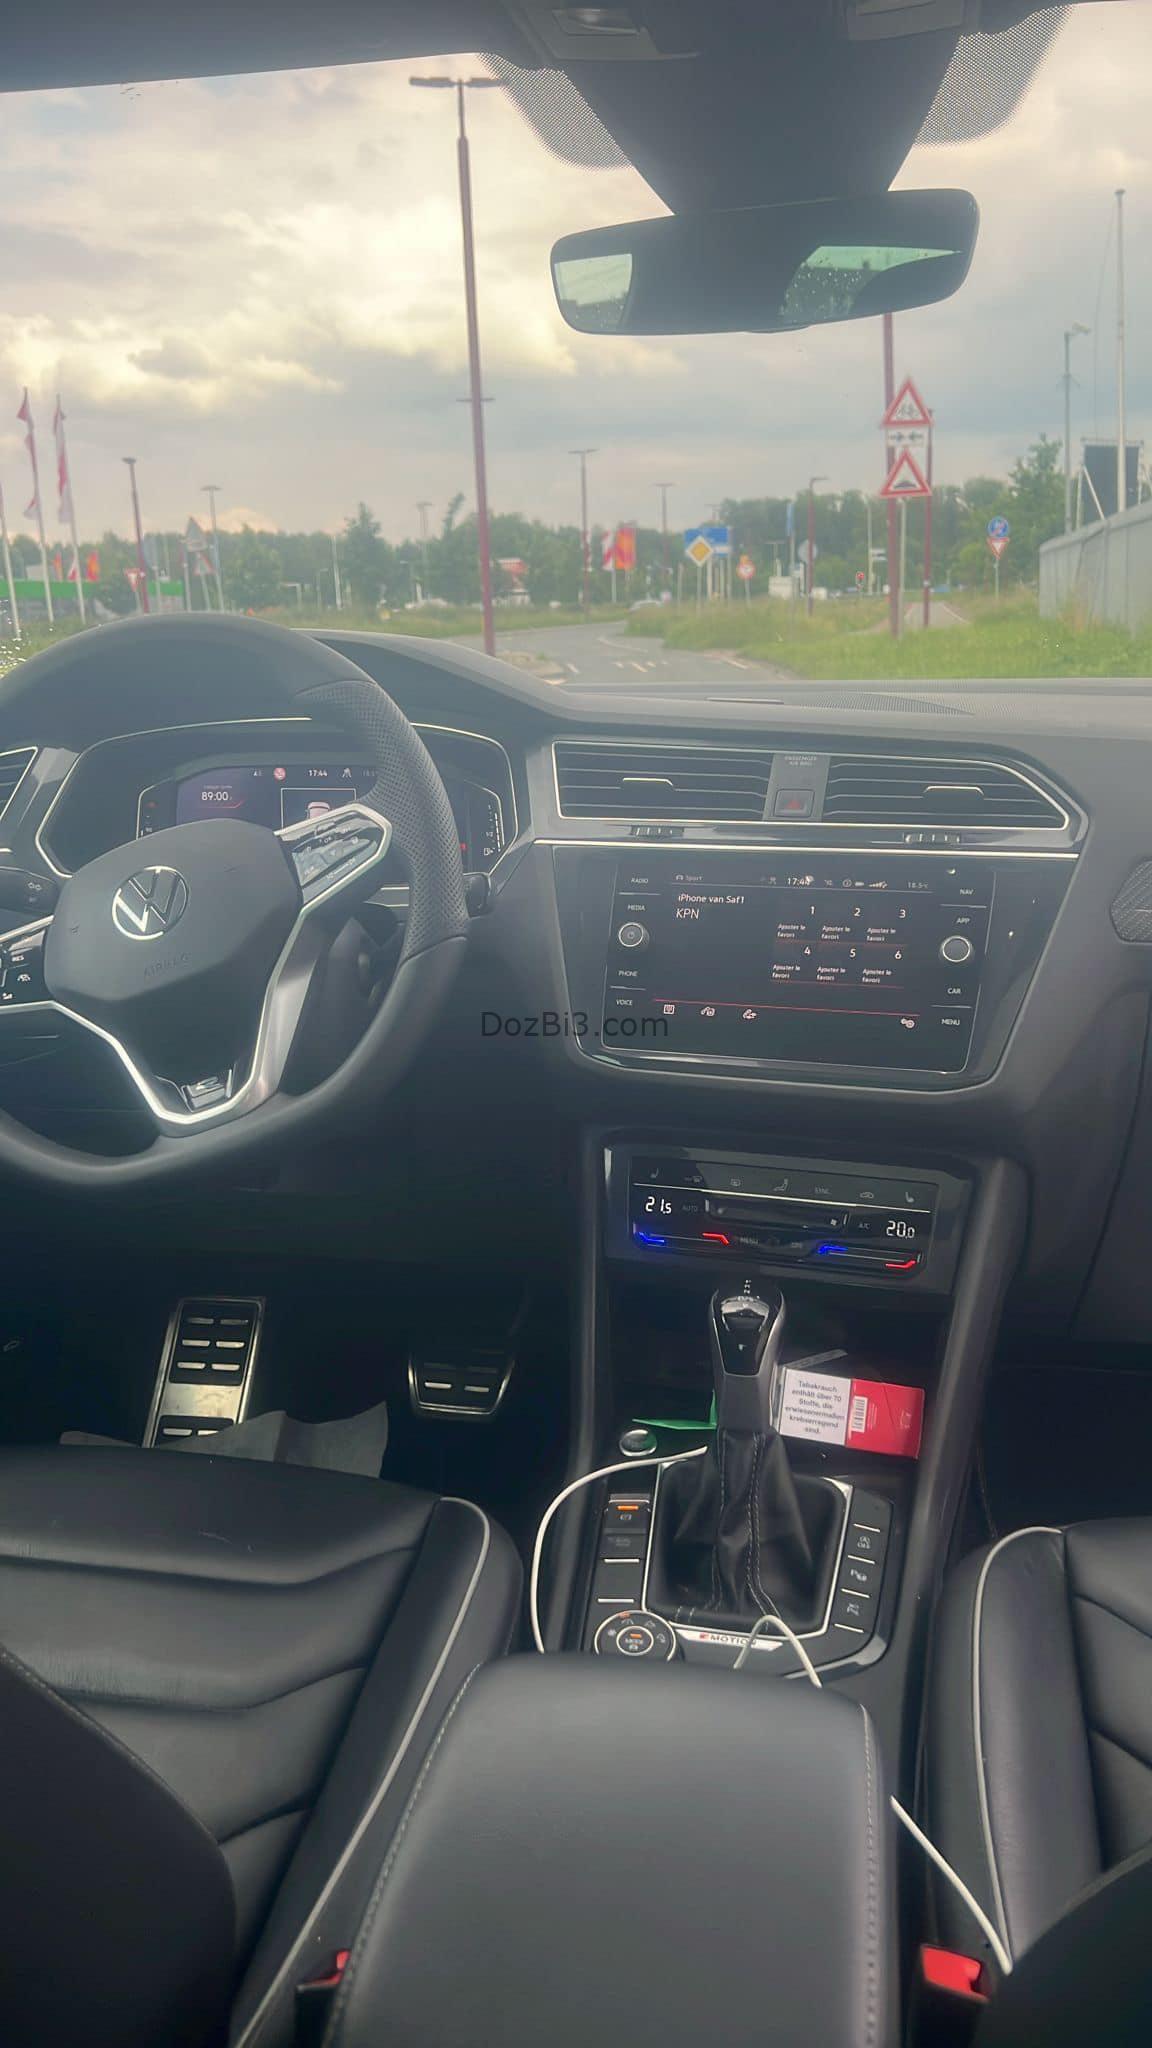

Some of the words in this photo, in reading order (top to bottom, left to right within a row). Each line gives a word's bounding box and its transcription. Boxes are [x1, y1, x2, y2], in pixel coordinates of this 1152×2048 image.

[202, 791, 229, 800] 89:00
[678, 893, 706, 903] iPhone
[676, 908, 700, 919] KPN
[810, 906, 815, 914] 1
[854, 908, 860, 916] 2
[899, 909, 906, 918] 3
[804, 946, 811, 955] 4
[850, 948, 856, 957] 5
[895, 950, 902, 959] 6
[799, 1381, 838, 1392] Tabakrauch
